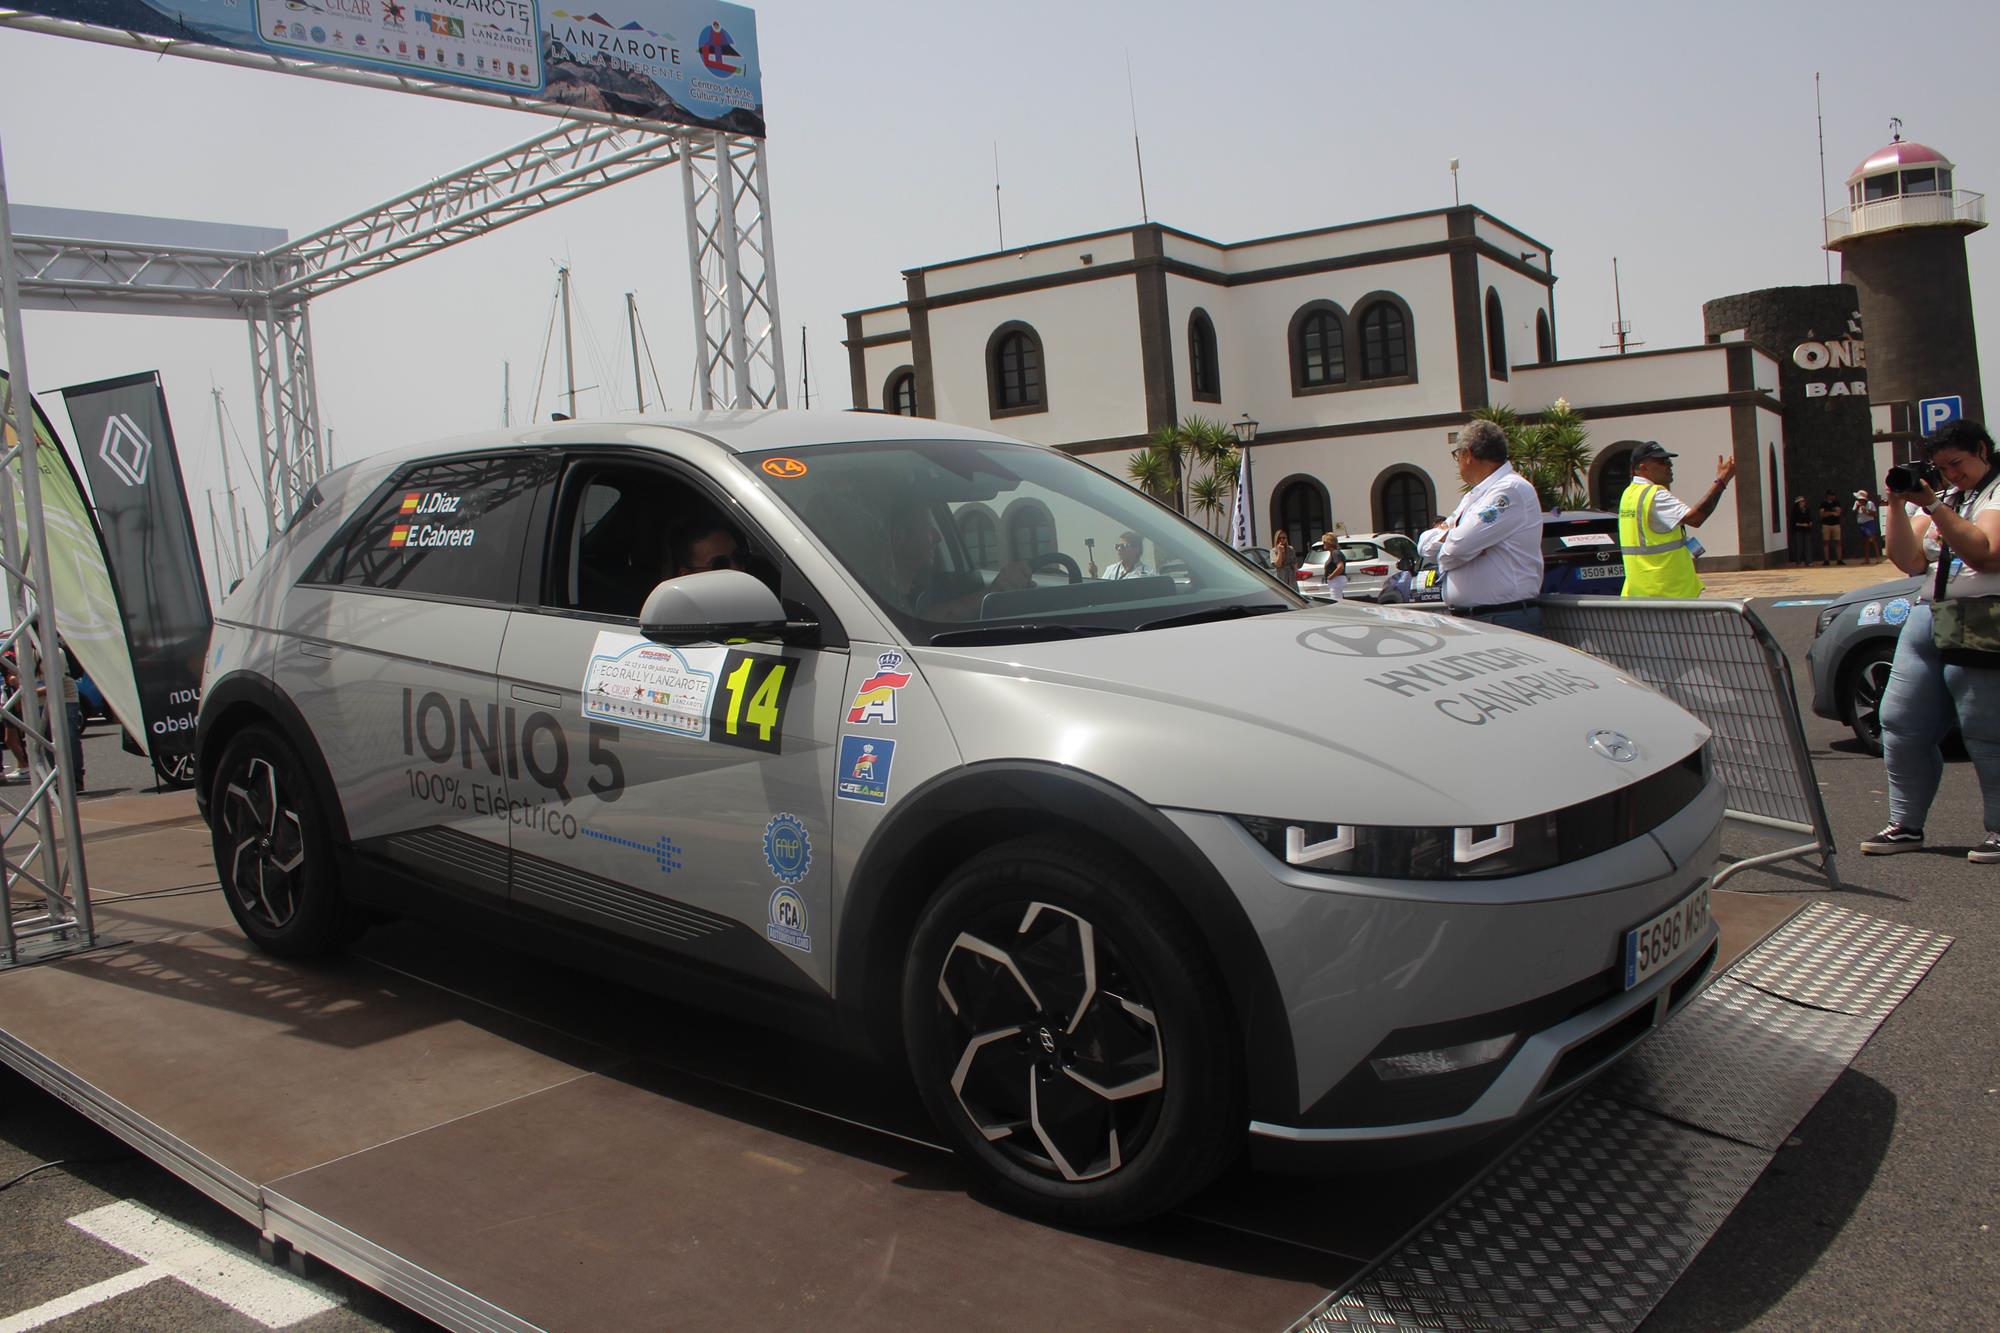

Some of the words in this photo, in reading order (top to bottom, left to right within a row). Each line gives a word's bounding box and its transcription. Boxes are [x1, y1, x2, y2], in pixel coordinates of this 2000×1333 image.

[326, 0, 371, 16] CICAR
[472, 28, 533, 48] LANZAROTE
[551, 23, 681, 65] LANZAROTE
[551, 44, 571, 60] LA
[575, 51, 606, 69] ISLA
[611, 55, 683, 81] DIFERENTE
[690, 88, 718, 102] Cultura
[726, 95, 756, 110] Turismo
[691, 77, 722, 93] Centros
[723, 85, 733, 94] de
[1927, 403, 1952, 431] P
[406, 525, 475, 547] E.Cabrera
[1582, 567, 1605, 578] 3509
[1364, 646, 1548, 698] HYUNDAI
[726, 658, 786, 741] 14
[1434, 668, 1600, 726] CANARIAS
[402, 687, 572, 807] IONIQ
[587, 722, 625, 803] 5
[405, 768, 467, 811] 100%
[471, 783, 577, 840] Eléctrico
[779, 902, 799, 927] FCA
[1639, 910, 1682, 972] 5696
